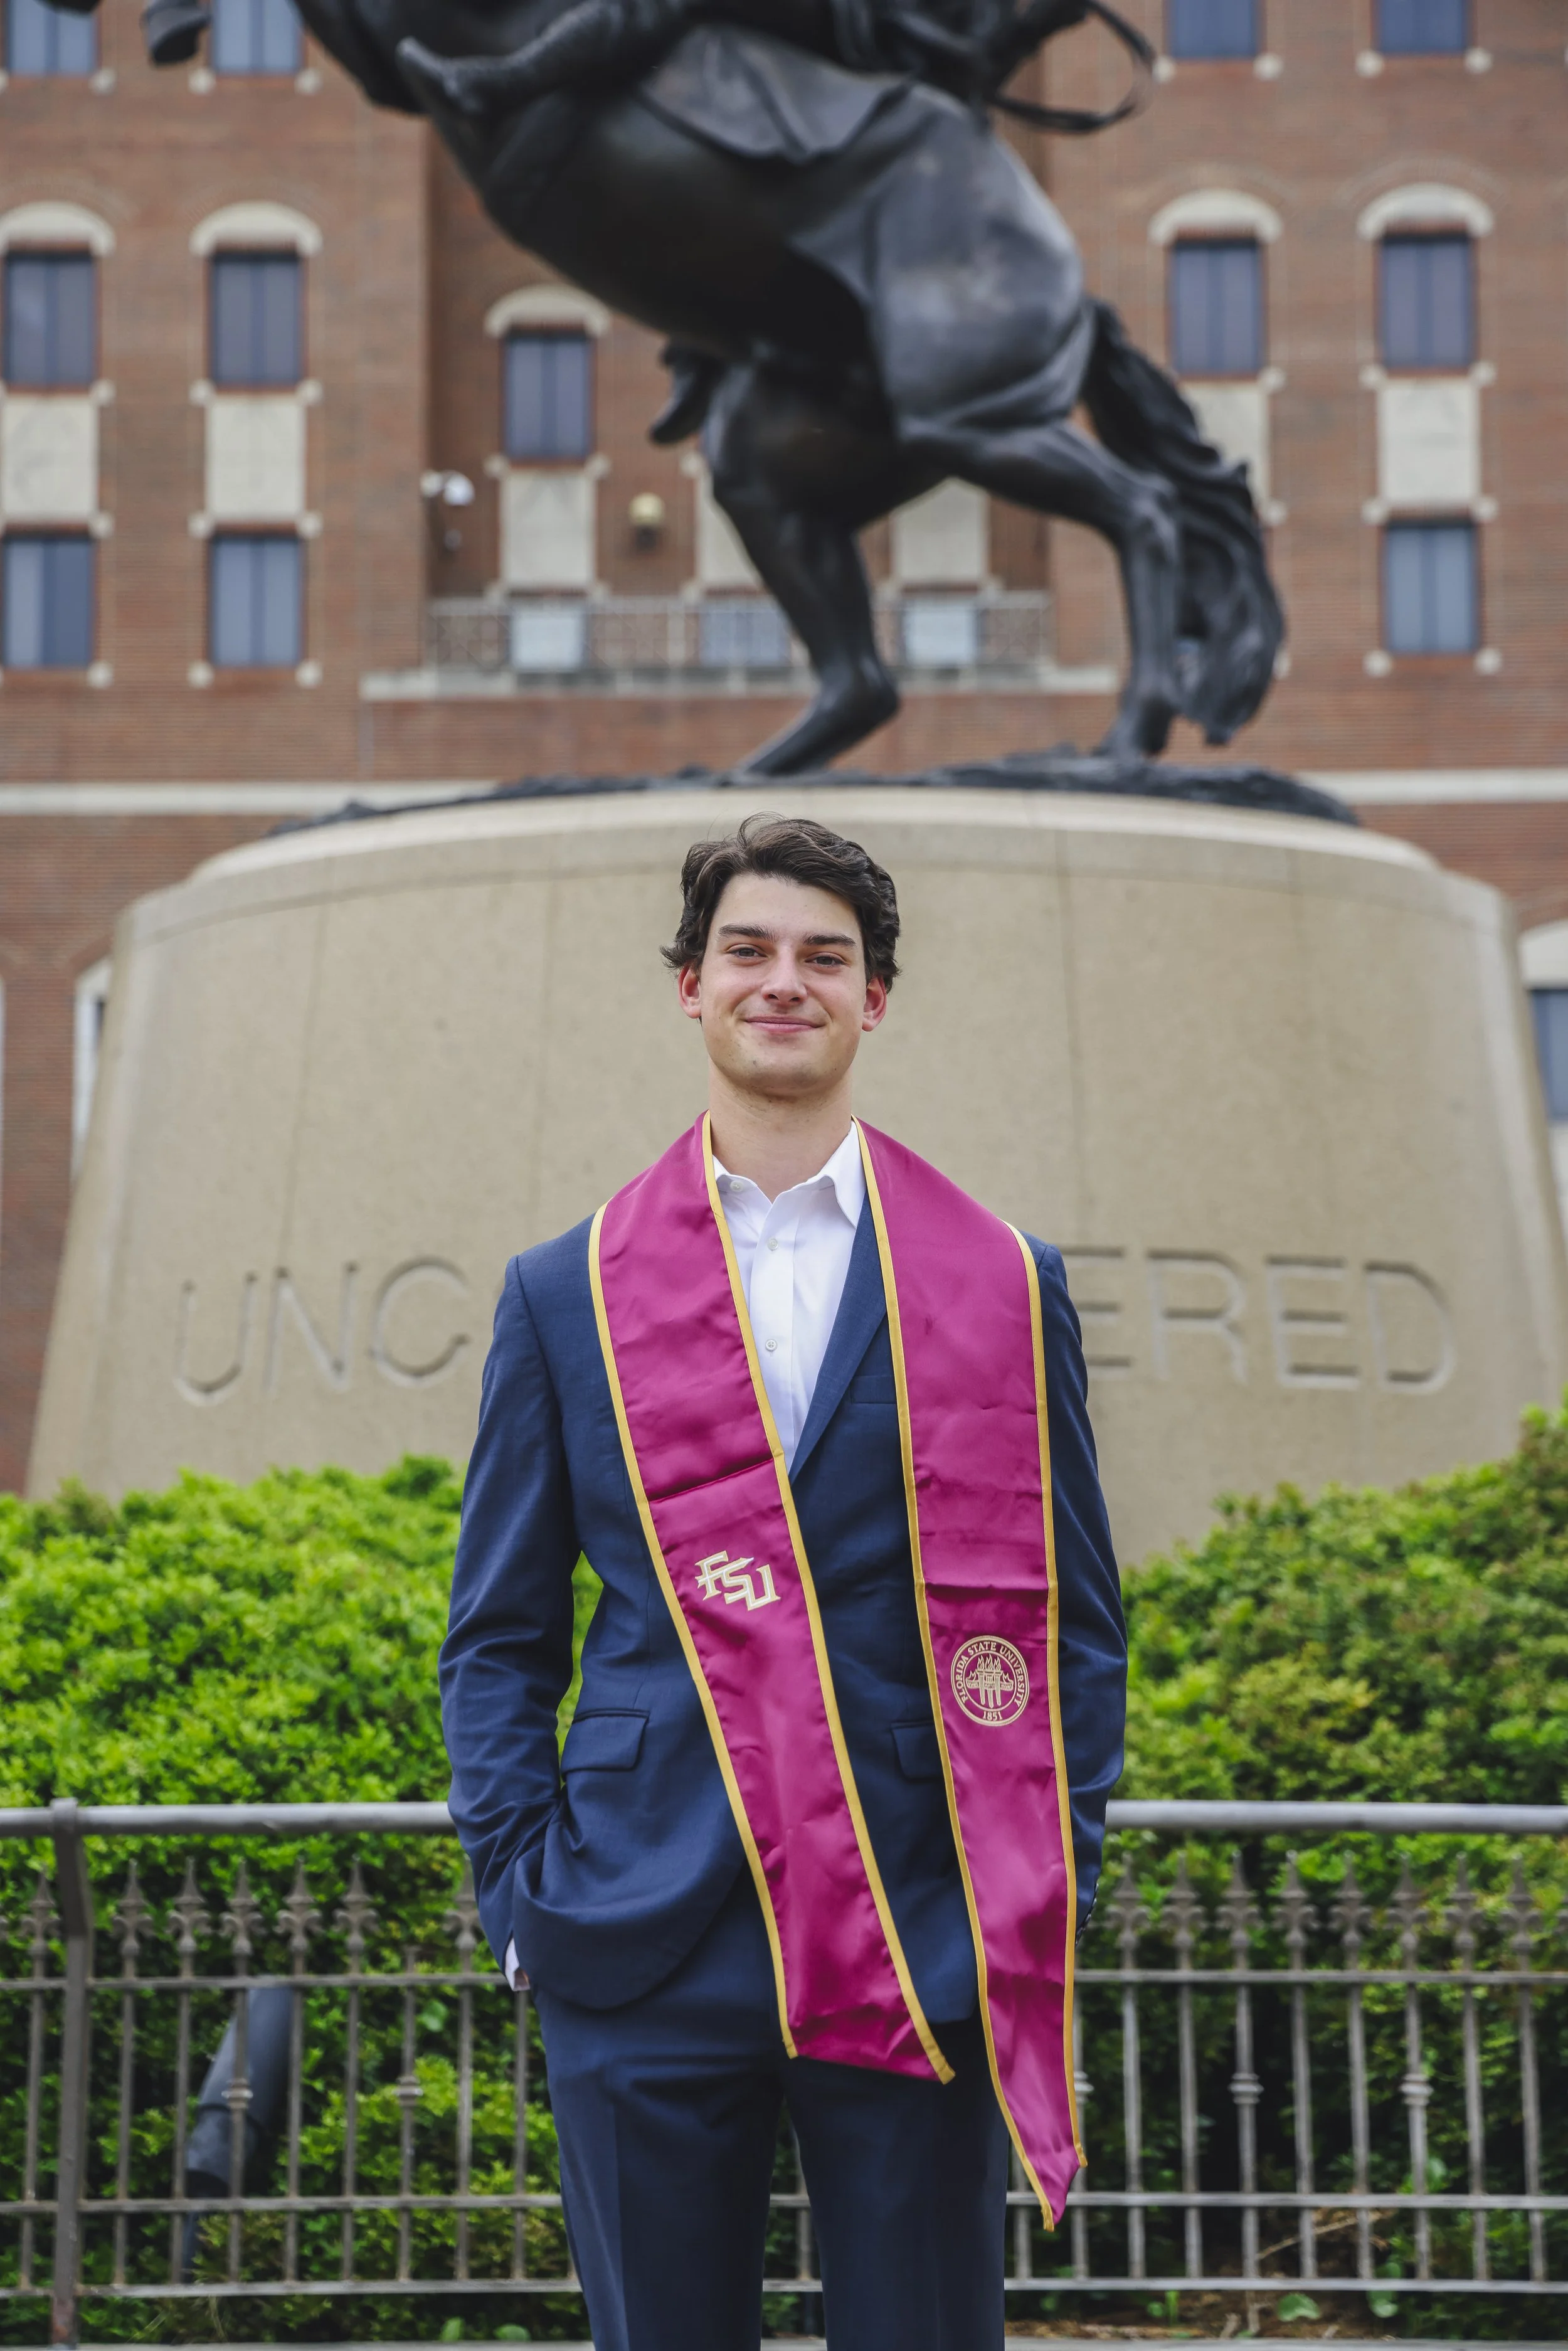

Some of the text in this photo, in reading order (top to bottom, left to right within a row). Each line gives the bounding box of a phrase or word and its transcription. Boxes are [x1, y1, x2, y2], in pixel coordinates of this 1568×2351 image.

[694, 1550, 781, 1611] FSU
[955, 1641, 1025, 1707] FLORIDA STATE UNIVERSITY
[983, 1711, 1003, 1721] 1851
